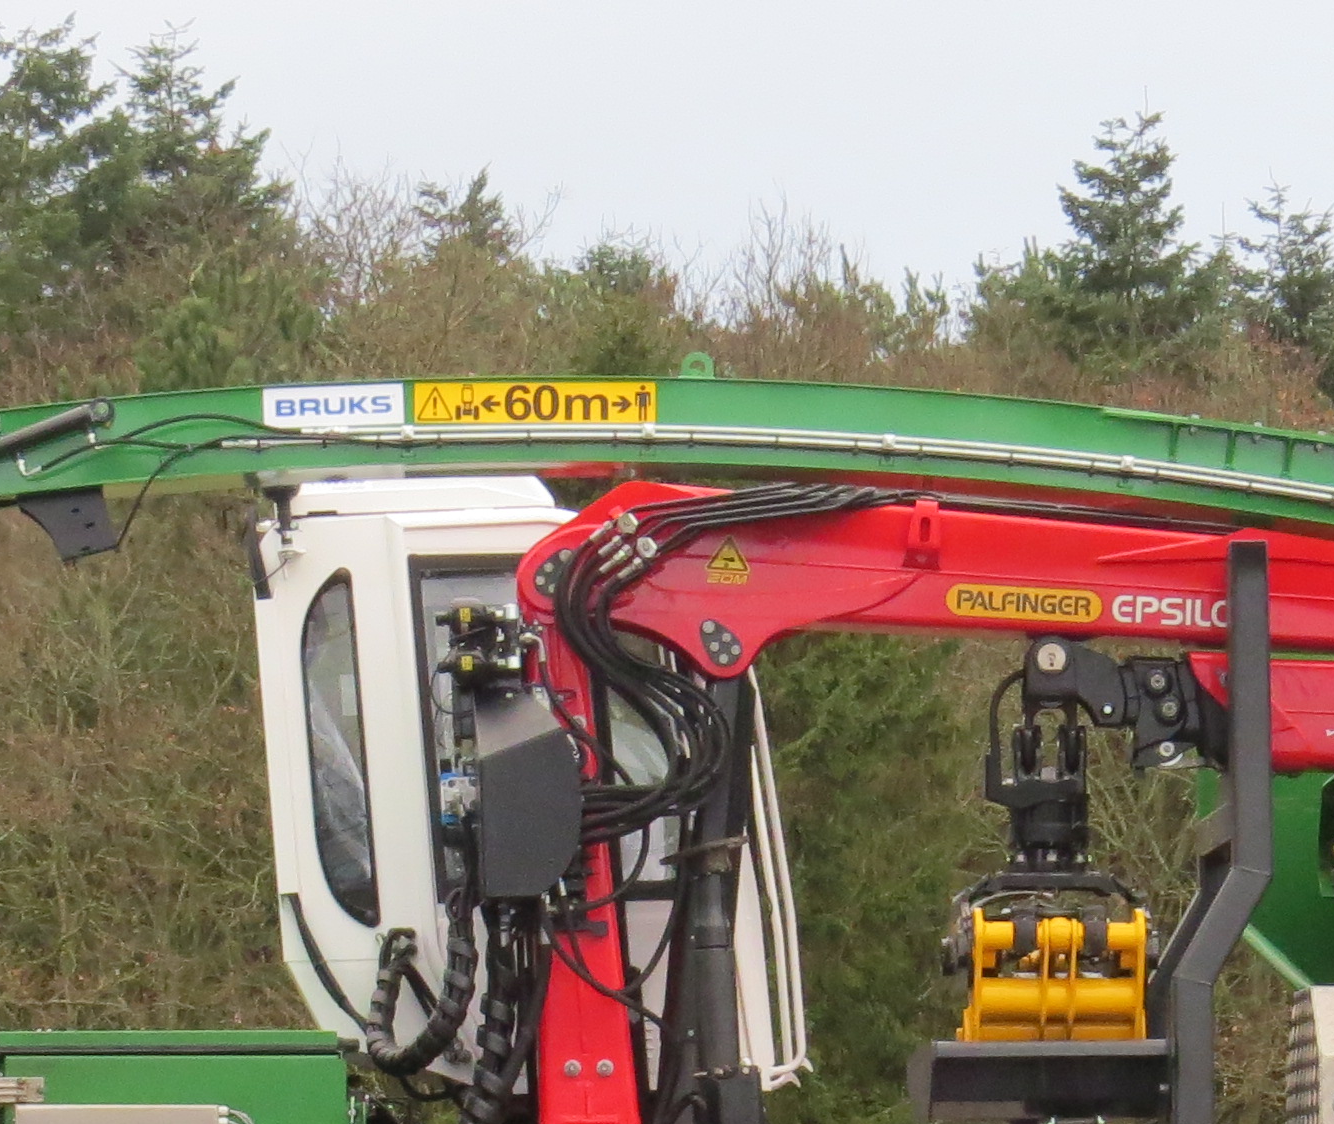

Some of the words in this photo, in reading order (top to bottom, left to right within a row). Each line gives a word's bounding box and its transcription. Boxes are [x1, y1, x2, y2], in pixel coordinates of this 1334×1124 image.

[275, 395, 393, 417] BRUKS
[504, 384, 609, 421] 60m
[956, 588, 1092, 617] PALFINGER
